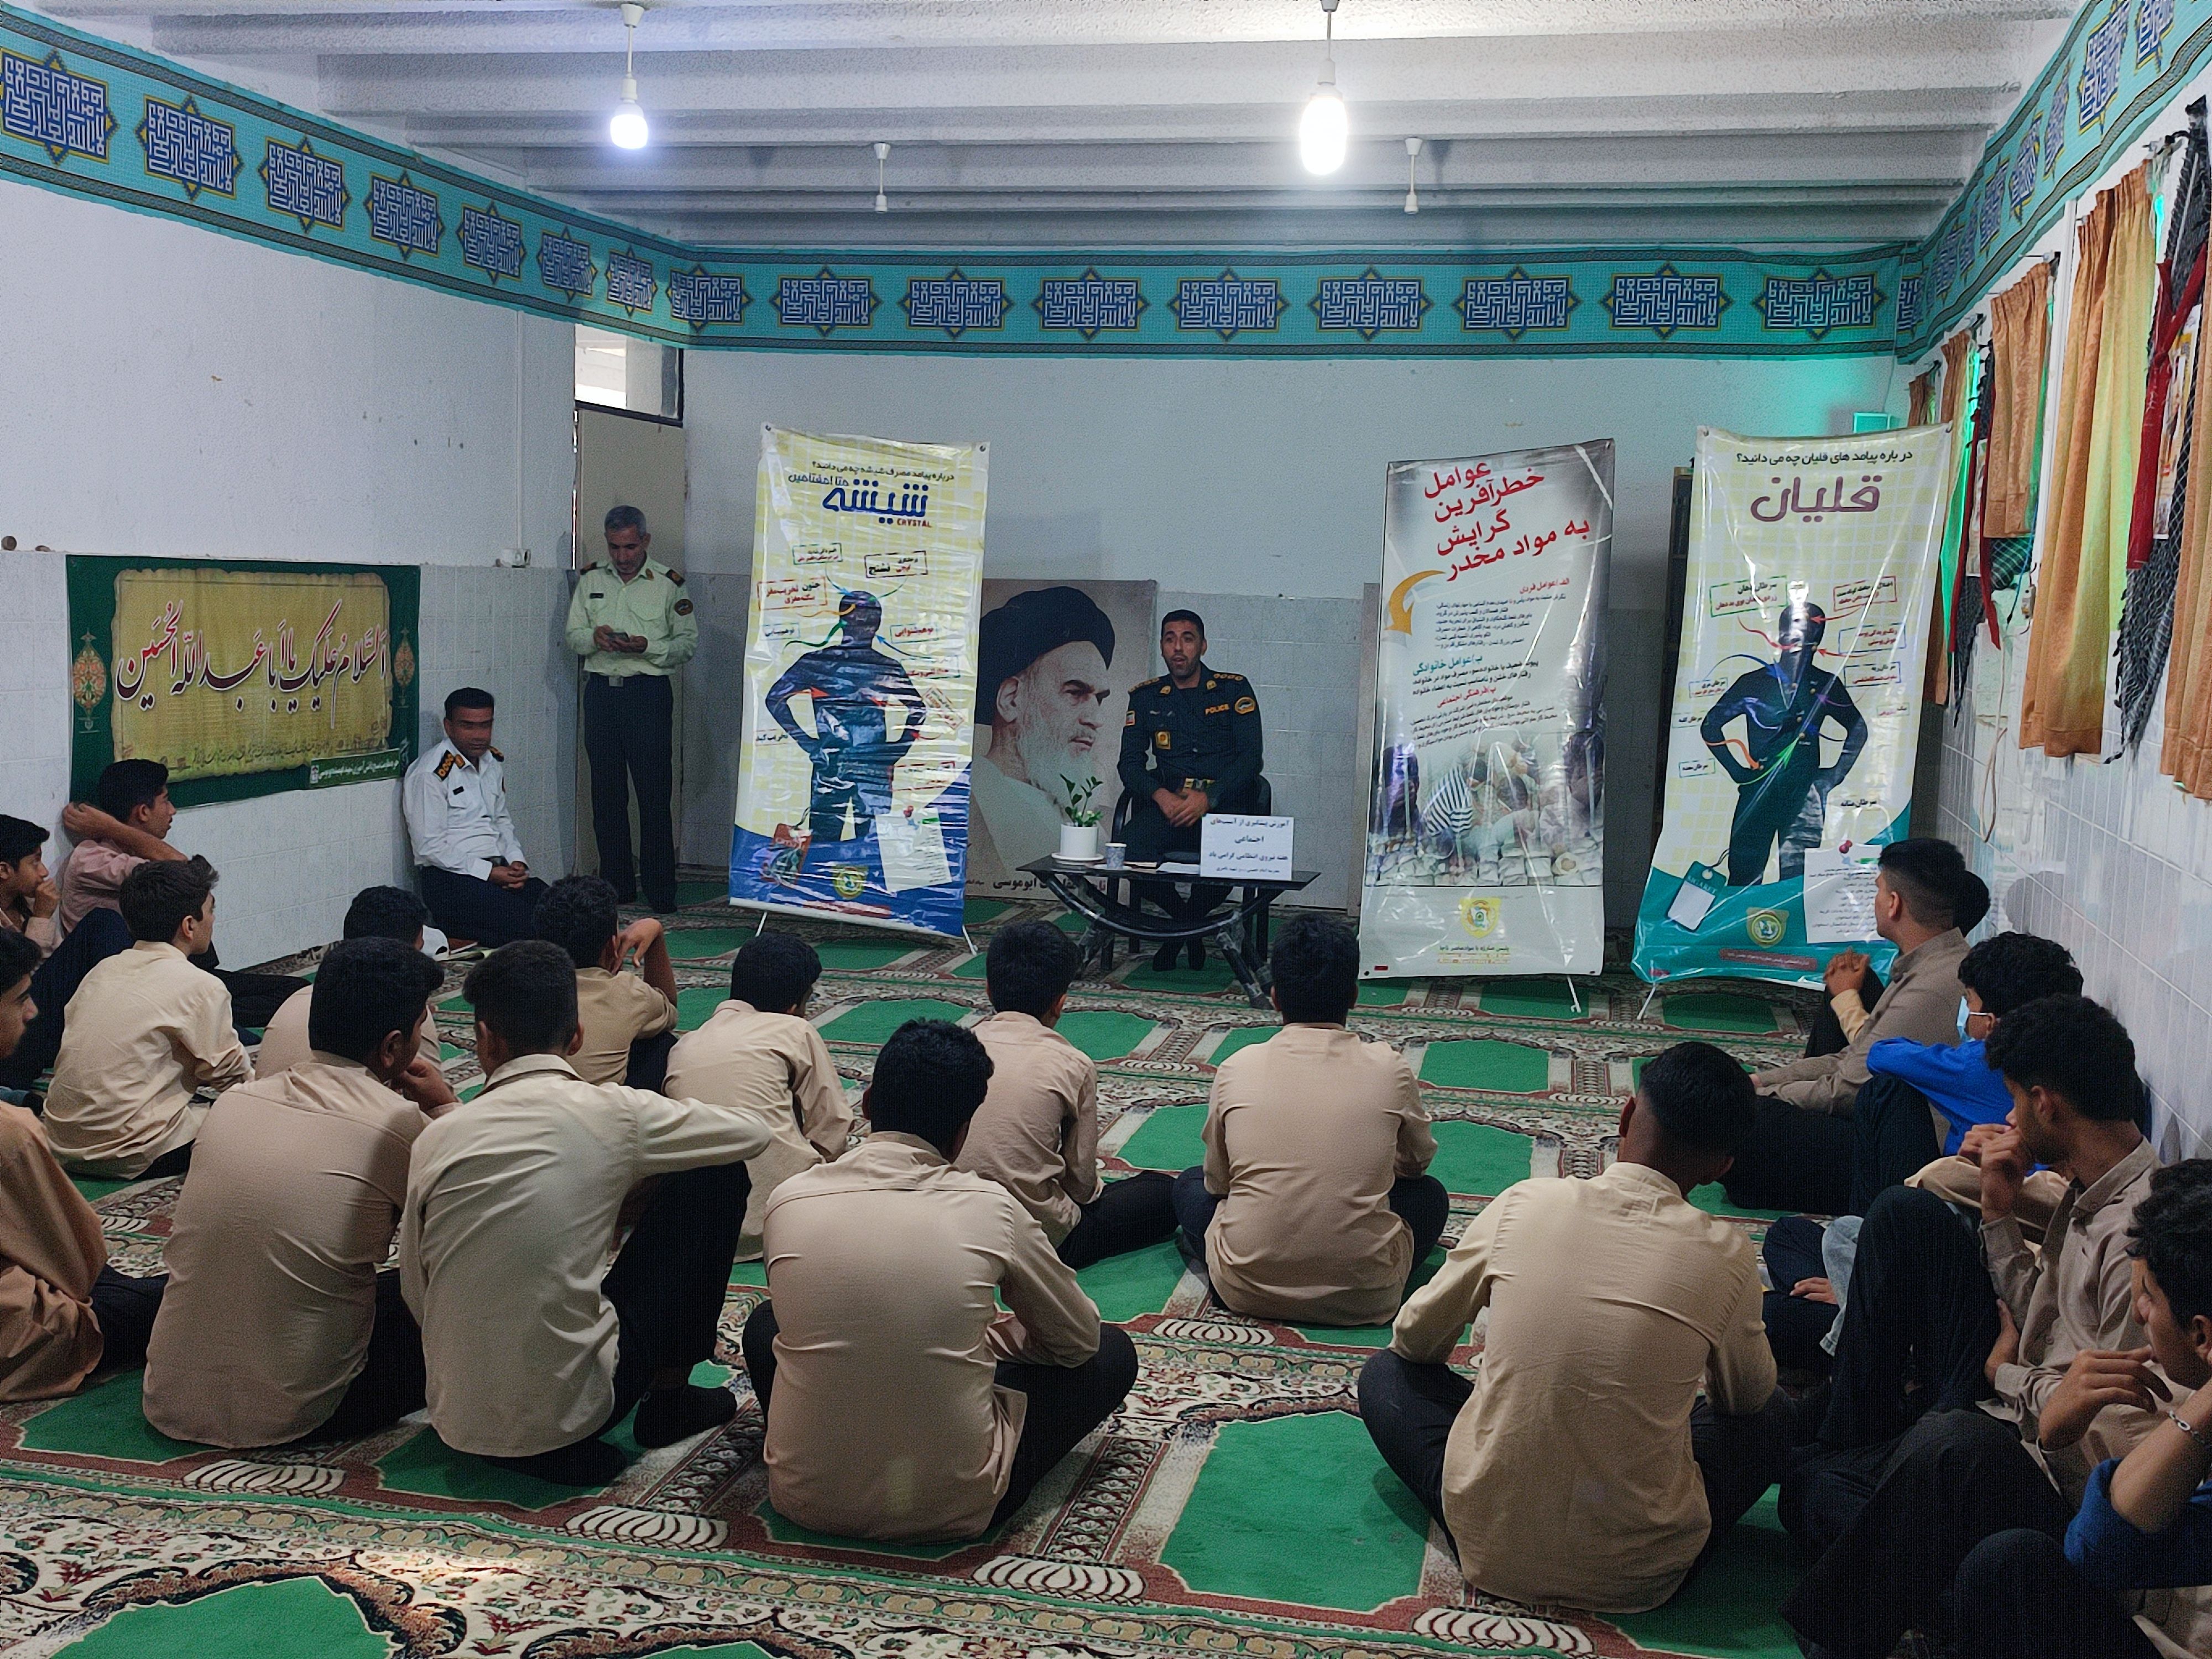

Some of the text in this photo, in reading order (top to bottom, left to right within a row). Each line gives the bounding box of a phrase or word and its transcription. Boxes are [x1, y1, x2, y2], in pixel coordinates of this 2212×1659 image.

[1769, 455, 1785, 465] می
[1786, 455, 1800, 466] چه
[1830, 451, 1850, 464] های
[1424, 462, 1491, 498] عوامل
[822, 478, 929, 525] شیشه
[1750, 474, 1882, 522] قلیان
[896, 518, 932, 528] CRYSTAL
[1437, 508, 1510, 556] گرایش
[1446, 519, 1590, 582] به مواد مخدر
[1205, 703, 1230, 715] POLICE
